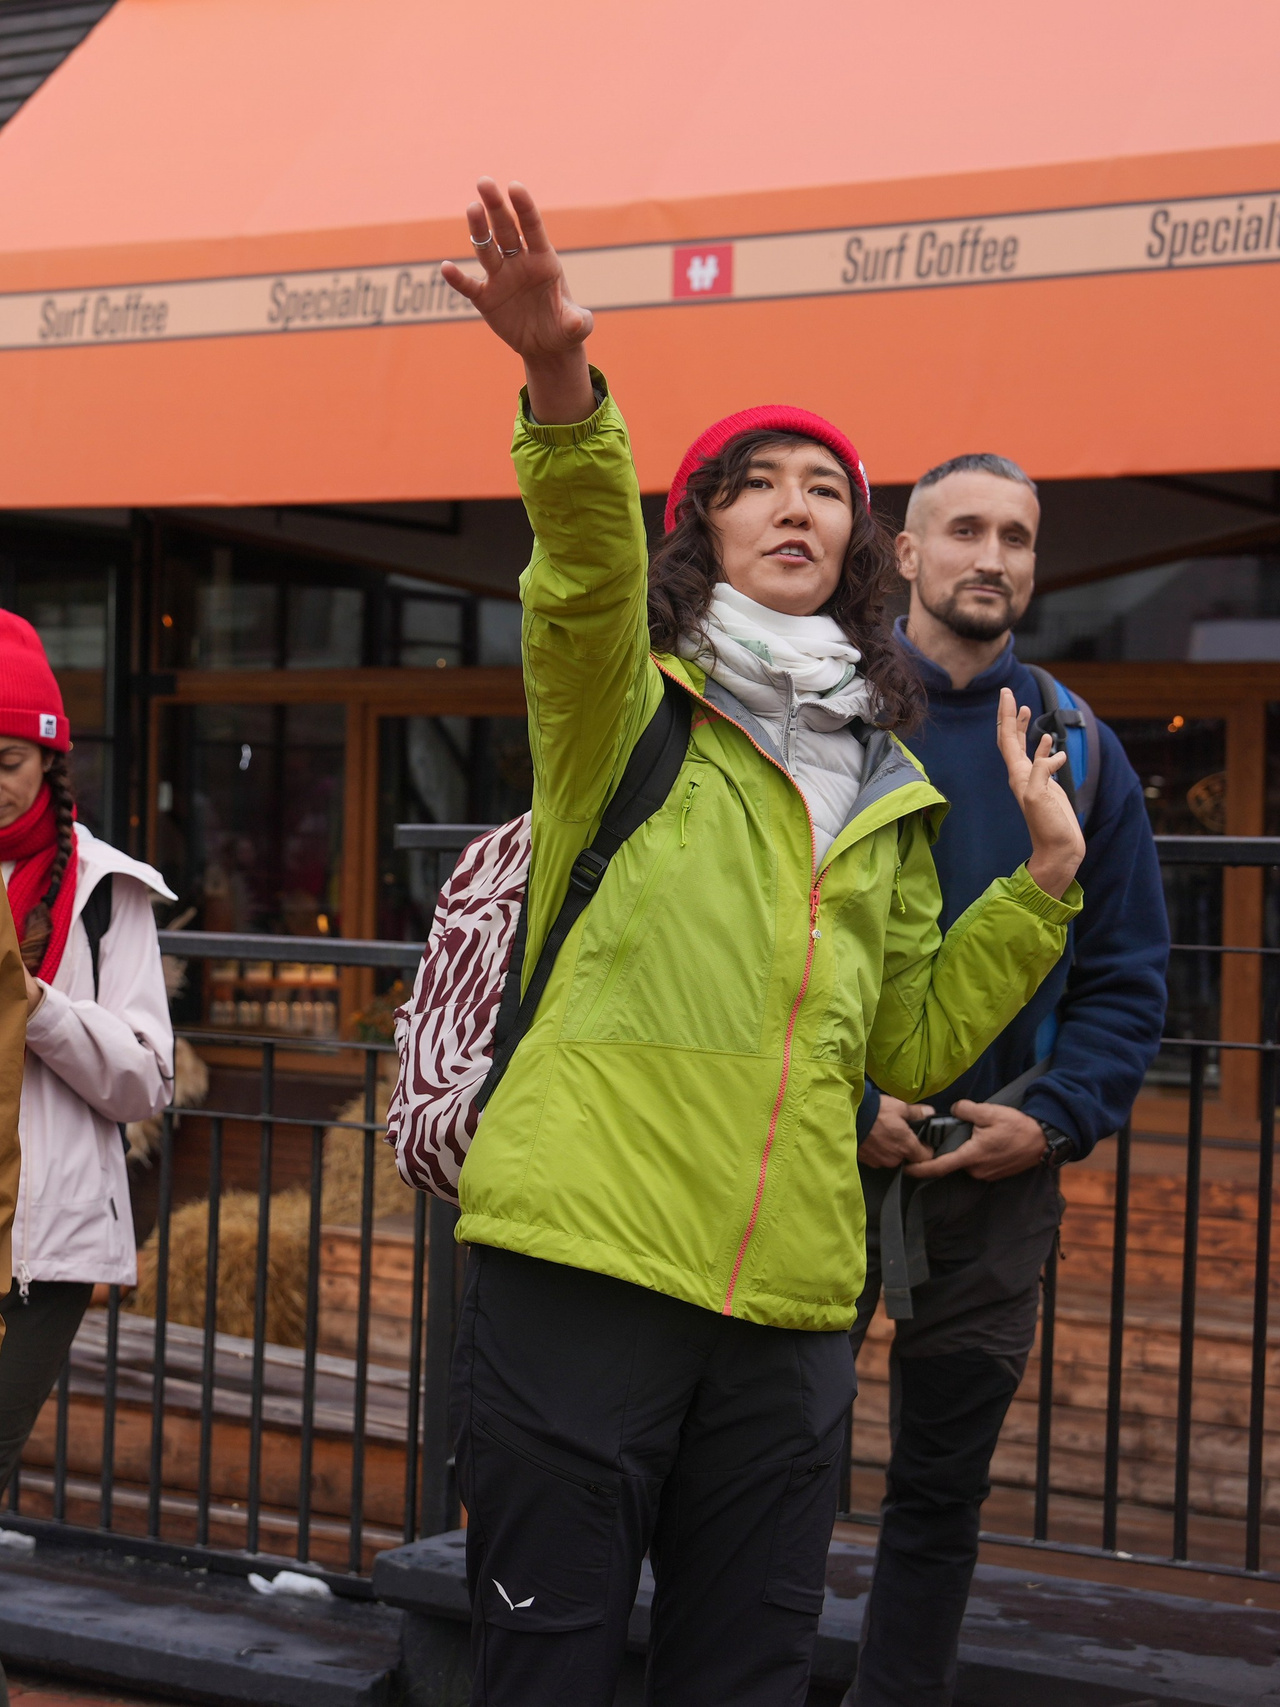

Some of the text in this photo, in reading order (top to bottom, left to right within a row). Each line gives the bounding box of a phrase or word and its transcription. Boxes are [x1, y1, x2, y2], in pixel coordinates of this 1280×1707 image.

[842, 226, 1019, 284] Surf Coffee
[39, 291, 168, 339] Surf Coffee
[268, 267, 474, 332] Specialty Coffe
